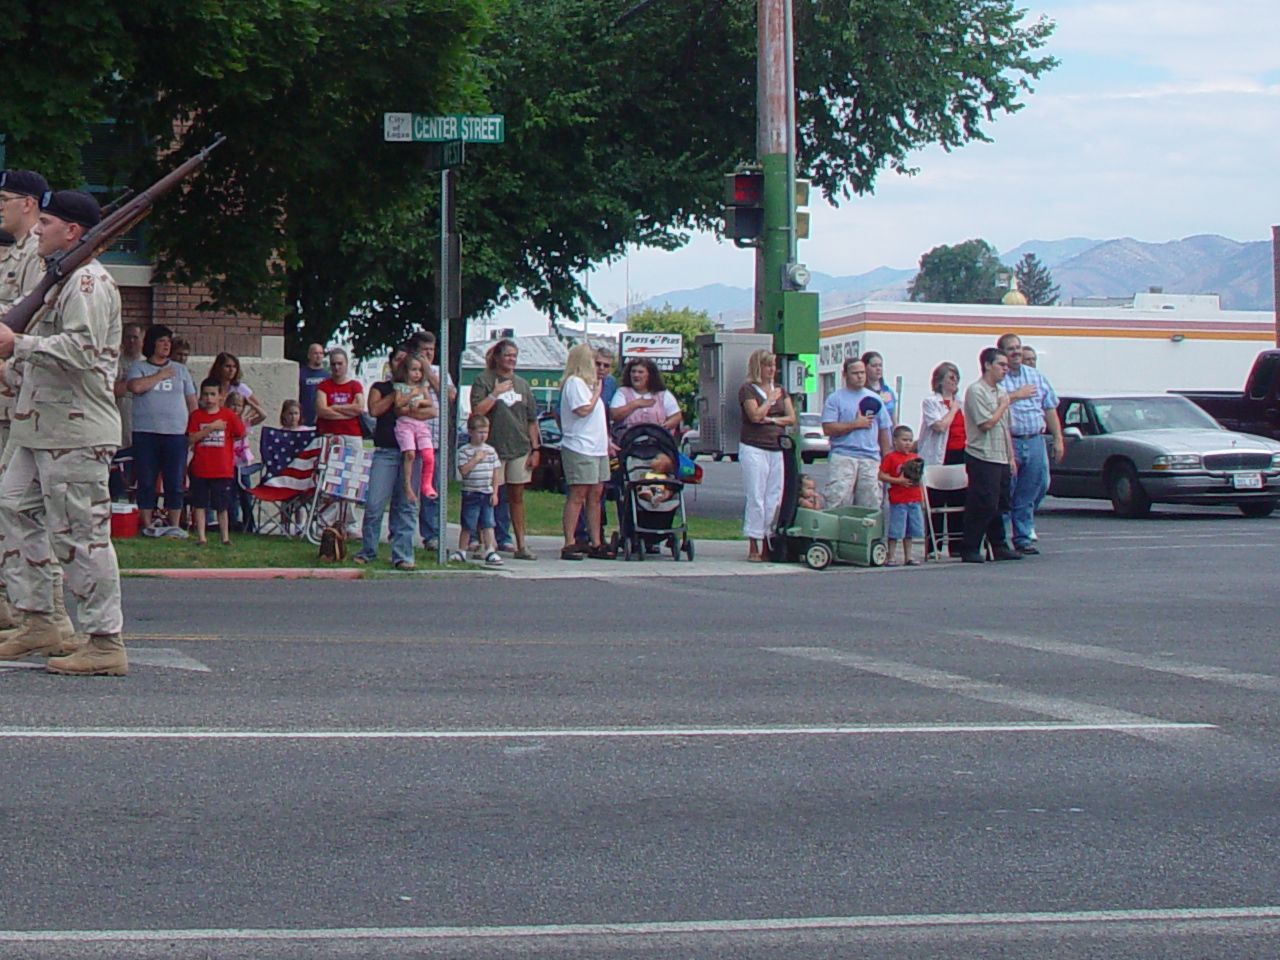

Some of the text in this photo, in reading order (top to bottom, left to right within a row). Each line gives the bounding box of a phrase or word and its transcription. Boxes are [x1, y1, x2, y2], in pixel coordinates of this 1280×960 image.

[388, 115, 405, 125] City
[414, 116, 502, 140] CENTER STREET
